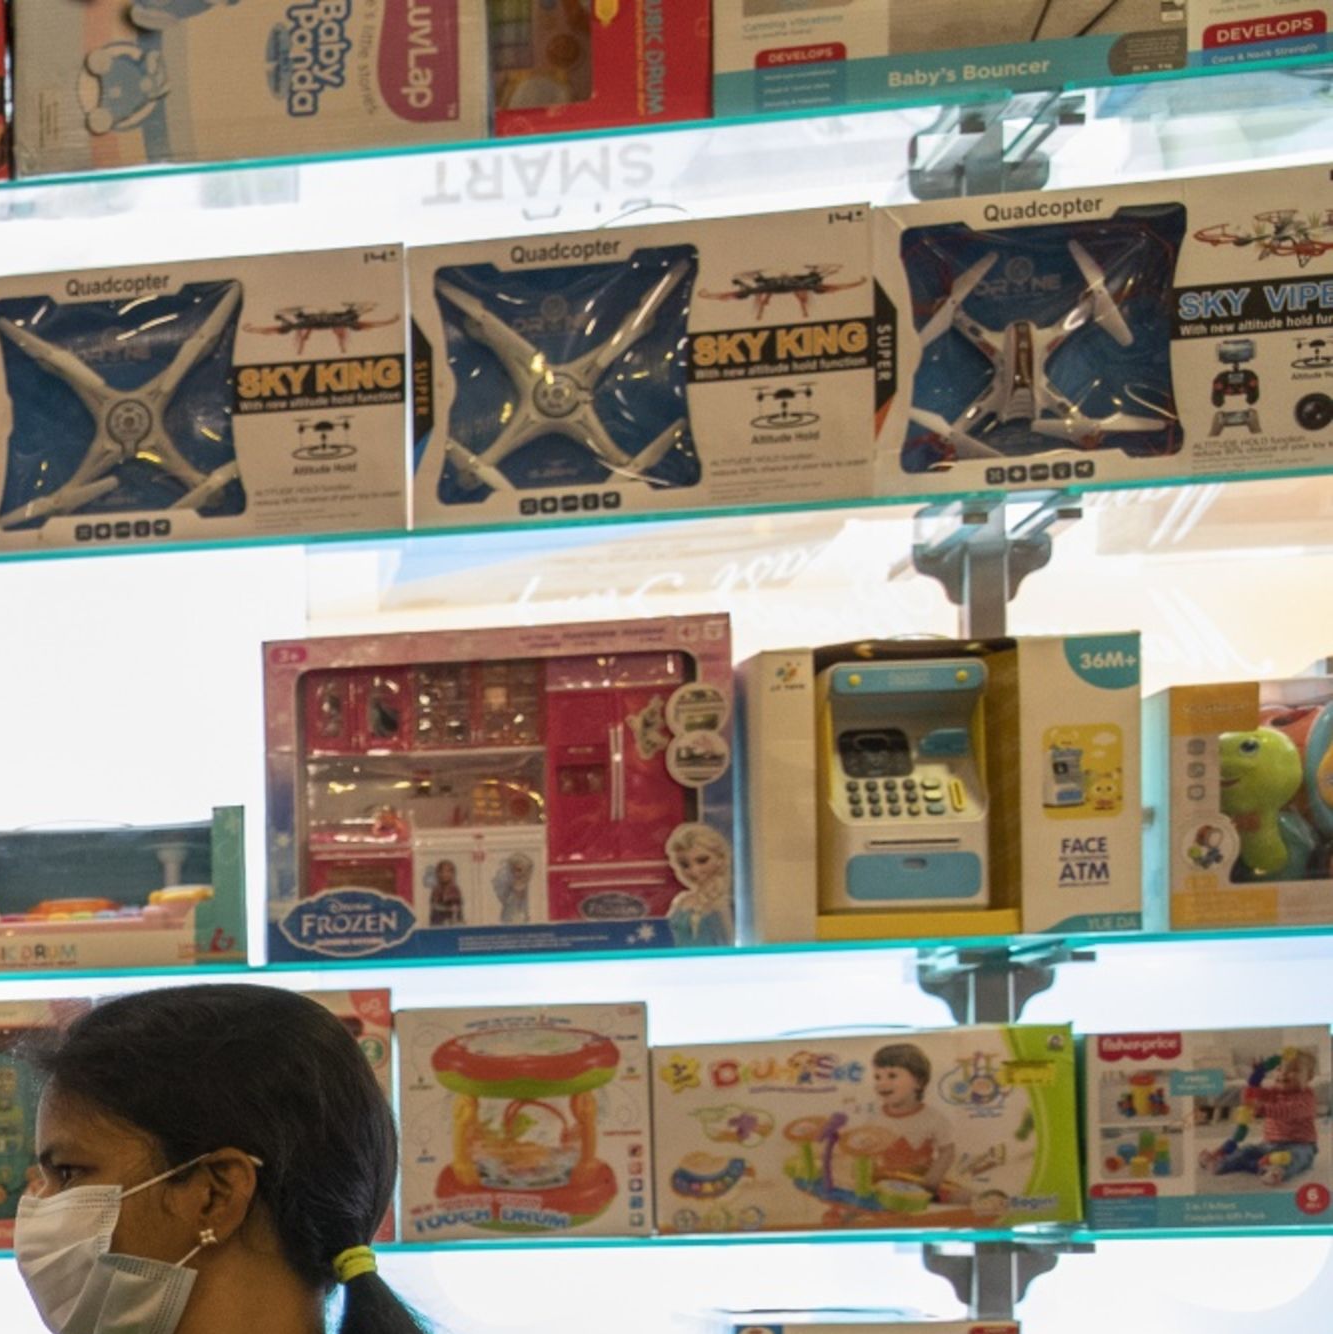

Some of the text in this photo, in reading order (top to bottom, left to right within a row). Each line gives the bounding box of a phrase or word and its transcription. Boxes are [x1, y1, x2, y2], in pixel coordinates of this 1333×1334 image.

[1216, 17, 1314, 43] DEVELOPS
[288, 3, 318, 116] panda
[645, 0, 666, 114] USIC DRUM
[768, 47, 834, 64] DEVELOPS
[1212, 43, 1319, 65] Core Neck Strength
[888, 56, 1051, 89] Baby's Bouncer
[983, 198, 1103, 222] Quadcopter
[510, 239, 621, 266] Quadcopter
[65, 274, 170, 298] Quadcopter
[1179, 288, 1250, 320] SKY
[1180, 313, 1308, 337] With new altitude hold
[693, 323, 868, 367] SKY KING
[876, 324, 893, 381] SUPER
[237, 358, 404, 399] SKY KING
[413, 360, 431, 417] SUPER
[1080, 650, 1137, 670] 36M+
[1060, 836, 1108, 854] FACE
[1059, 861, 1110, 881] ATM
[301, 913, 400, 936] FROZEN
[21, 944, 78, 961] DRUM
[1102, 1036, 1178, 1051] fisher-price
[1305, 1188, 1319, 1201] 6
[414, 1206, 572, 1233] TOUCH DRUM
